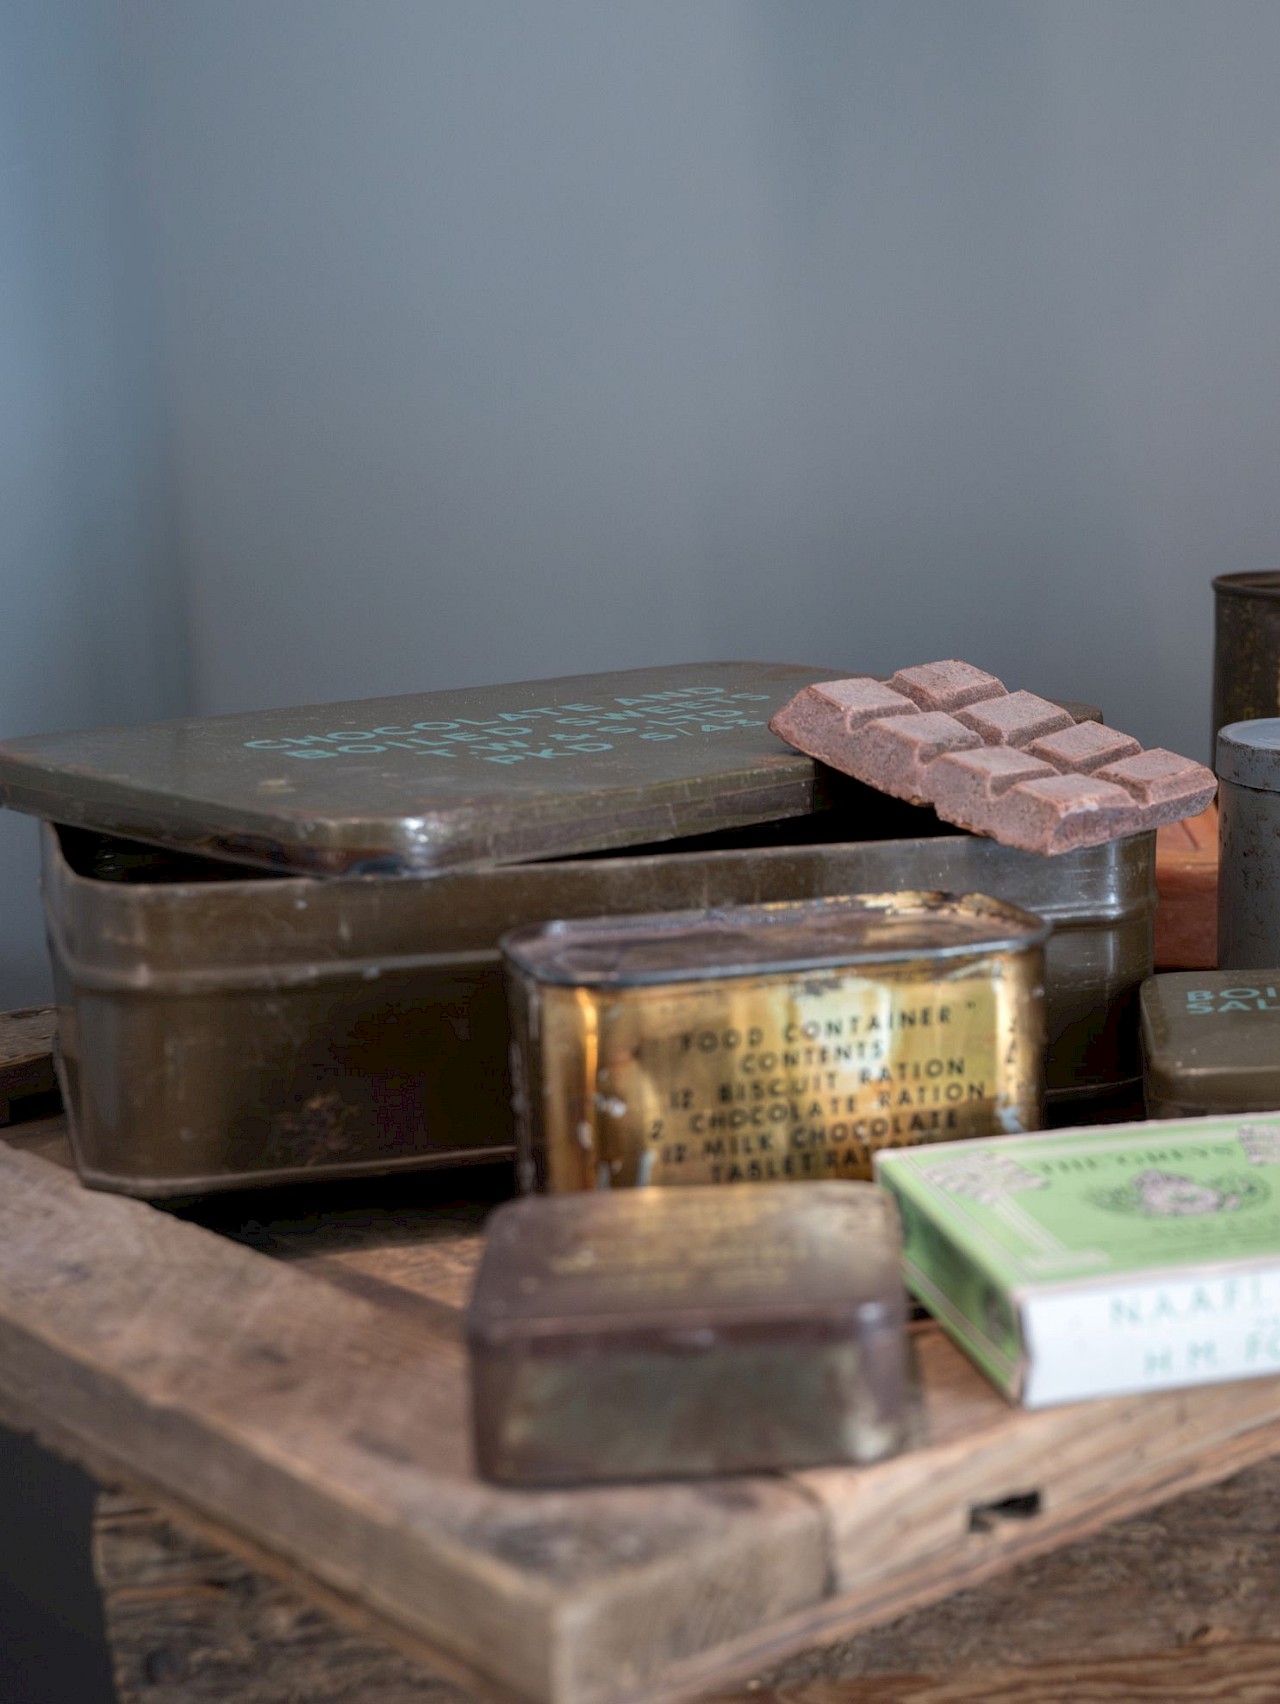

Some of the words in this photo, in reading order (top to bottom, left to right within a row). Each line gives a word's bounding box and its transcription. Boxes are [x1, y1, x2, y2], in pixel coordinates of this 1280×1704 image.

[244, 703, 605, 749] CHOCOLATE
[614, 687, 725, 706] AND
[284, 726, 533, 760] BOILED
[556, 692, 771, 727] SWEETS
[483, 742, 614, 765] PKD
[680, 1027, 764, 1053] FOOD
[741, 1041, 883, 1074] CONTENTS
[718, 1072, 836, 1104] BISCUIT
[859, 1057, 965, 1084] RATION
[689, 1096, 855, 1134] CHOCOLATE
[878, 1081, 985, 1107] RATION
[703, 1133, 772, 1157] MILK
[790, 1108, 958, 1149] CHOCOLATE
[711, 1152, 812, 1183] TABLET
